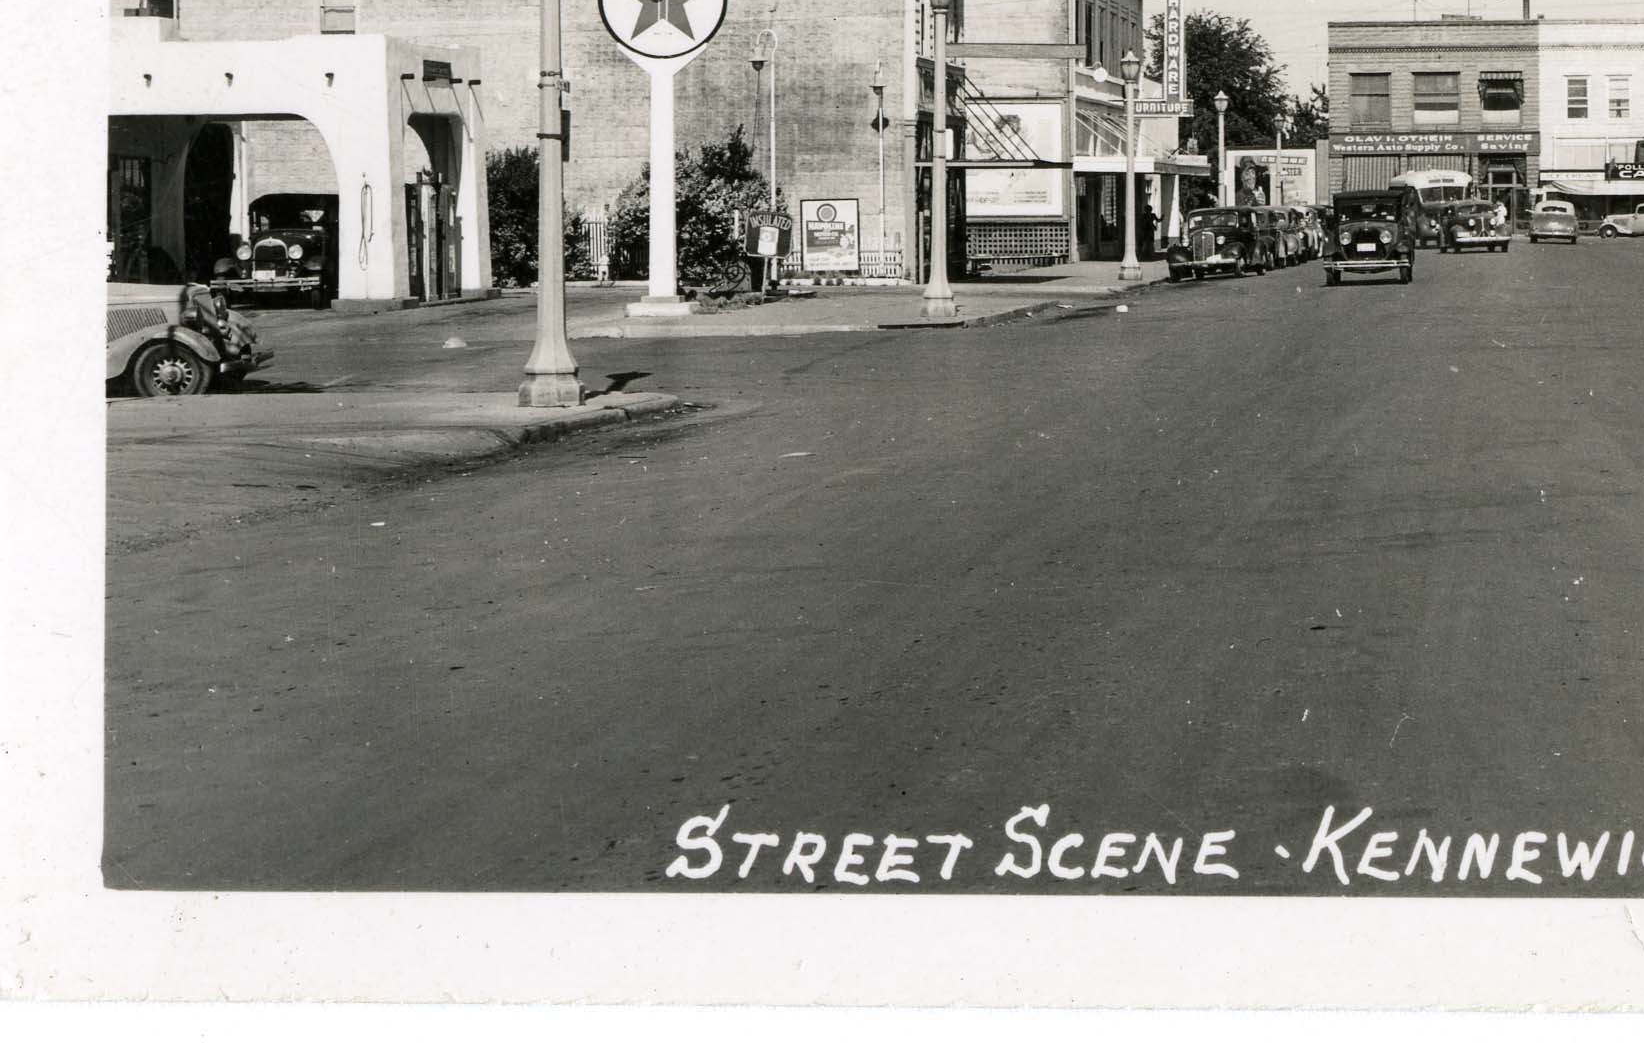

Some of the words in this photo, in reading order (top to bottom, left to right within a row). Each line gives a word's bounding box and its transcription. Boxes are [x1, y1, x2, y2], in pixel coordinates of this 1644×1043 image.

[1135, 102, 1188, 114] URNITURE
[1332, 144, 1375, 152] Western
[1405, 144, 1441, 153] Supply
[749, 214, 792, 231] INSULATED
